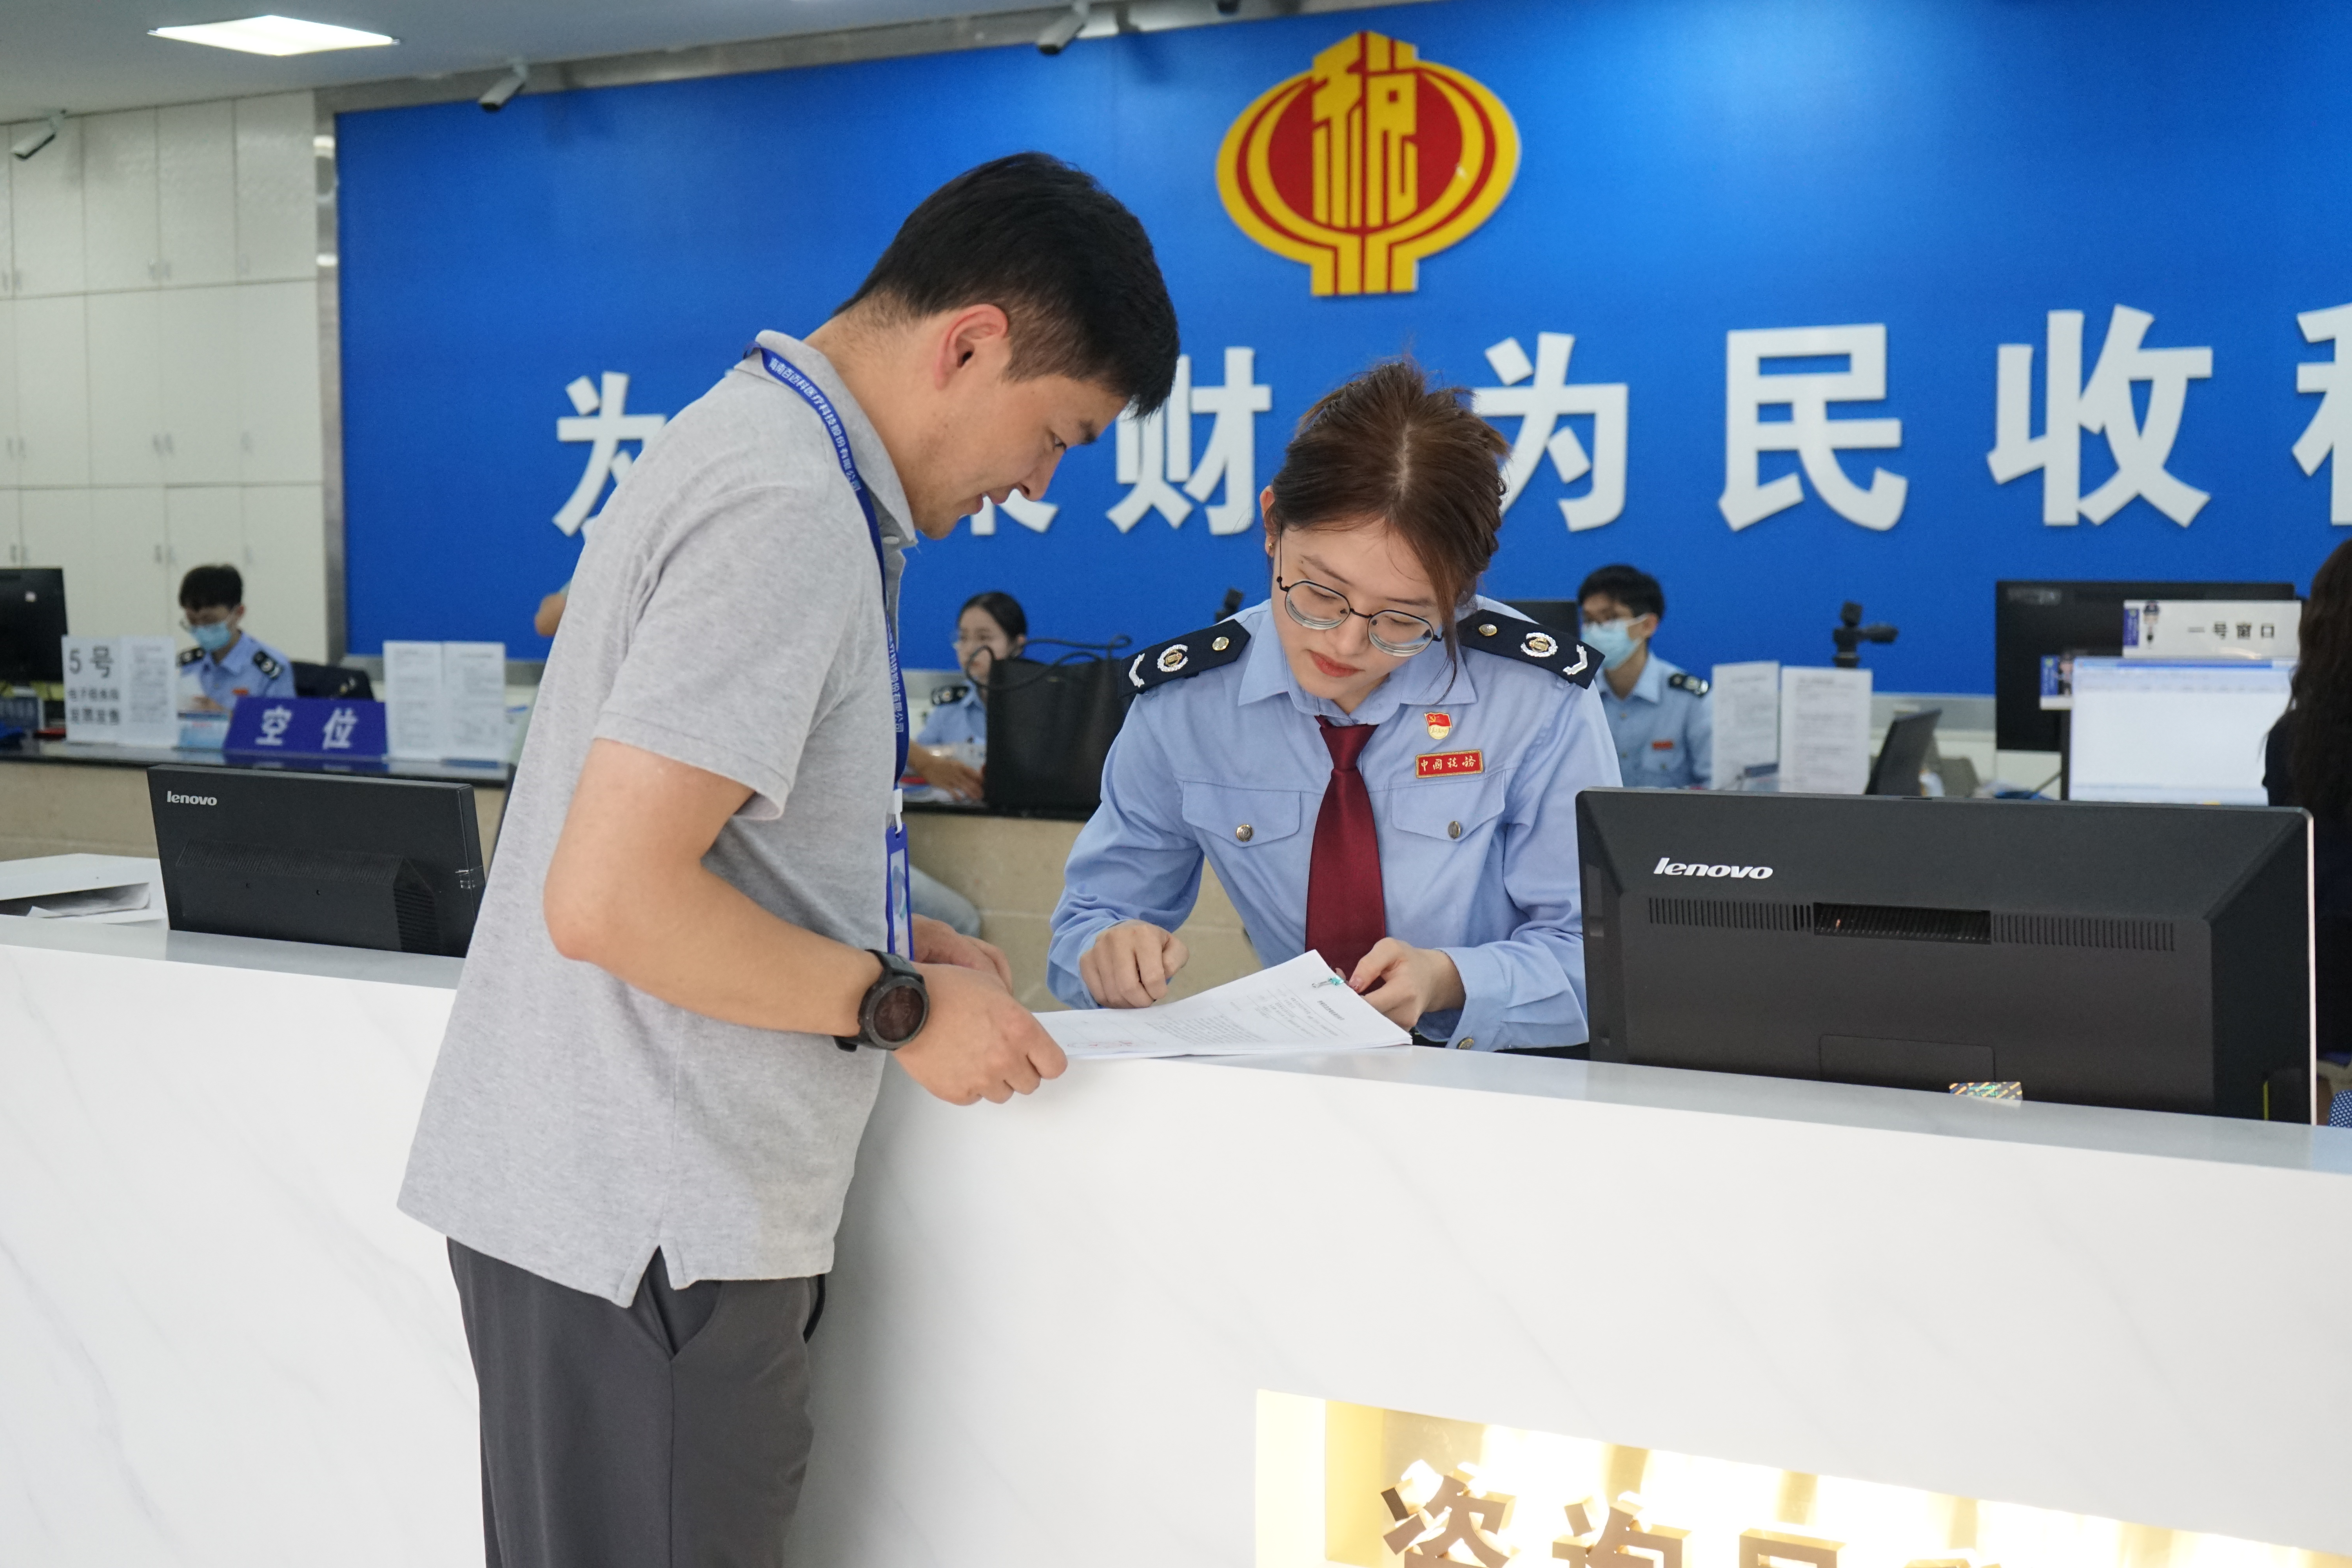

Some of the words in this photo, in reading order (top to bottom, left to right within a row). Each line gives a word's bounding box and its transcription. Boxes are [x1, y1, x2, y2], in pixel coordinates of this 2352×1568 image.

[2187, 621, 2275, 640] 一号窗口
[69, 646, 114, 679] 5号
[254, 705, 358, 750] 空位
[167, 791, 217, 806] lenovo
[1653, 857, 1773, 879] lenovo
